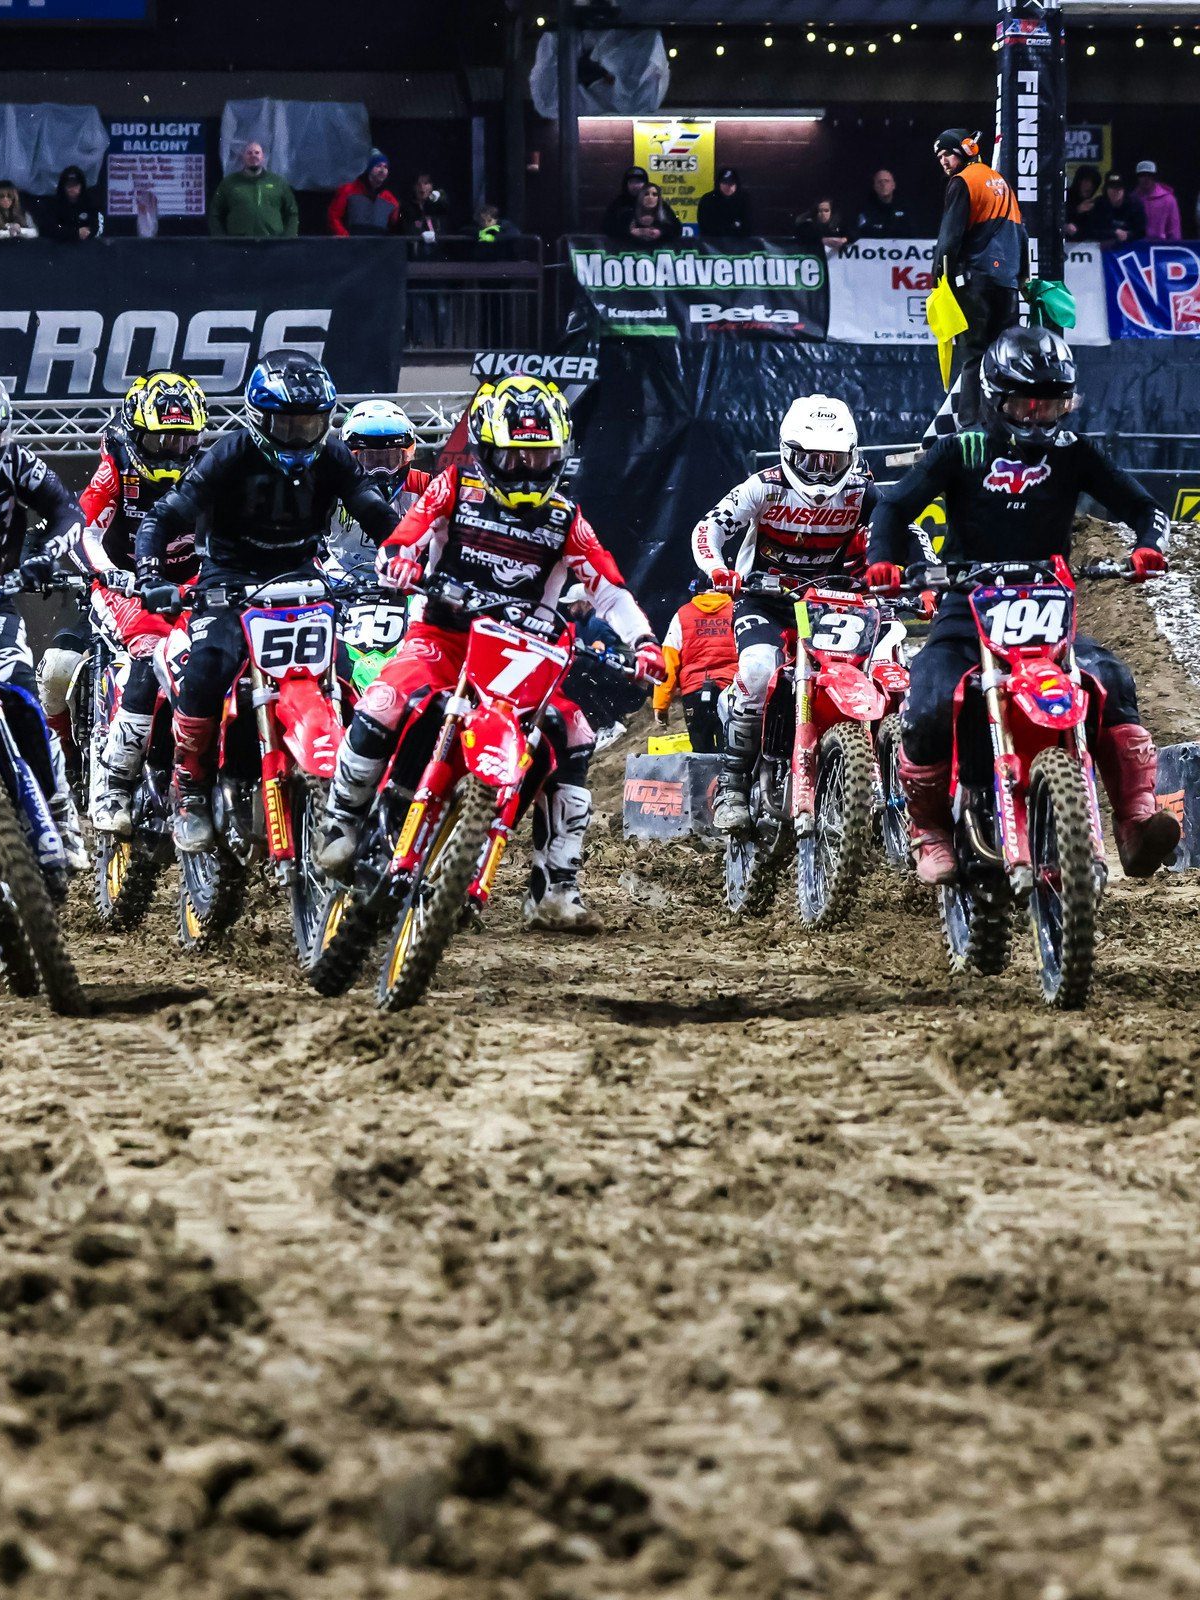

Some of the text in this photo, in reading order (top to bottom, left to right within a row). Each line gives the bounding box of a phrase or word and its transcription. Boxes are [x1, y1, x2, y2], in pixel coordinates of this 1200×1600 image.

[111, 123, 201, 136] BUD LIGHT
[1017, 70, 1039, 202] FINISH
[123, 140, 189, 152] BALCONY
[649, 155, 698, 171] EAGLES
[575, 253, 821, 287] MotoAdventure
[607, 306, 668, 319] Kawasaki
[689, 304, 799, 323] Beta
[494, 354, 599, 380] KICKER
[811, 411, 836, 421] Arai
[513, 433, 550, 441] AUCTION
[763, 504, 859, 527] ANSWER
[1006, 501, 1027, 510] FOX
[455, 513, 509, 535] MOOSE
[460, 545, 524, 570] PHOENIX
[343, 604, 405, 646] 55
[694, 618, 731, 627] TRACK
[695, 627, 729, 637] CREW
[812, 613, 866, 651] 3
[985, 598, 1067, 646] 194
[260, 626, 328, 669] 58
[823, 650, 855, 659] HONDA
[485, 647, 547, 696] 1
[623, 778, 684, 805] MOOSE
[639, 802, 683, 817] RACING
